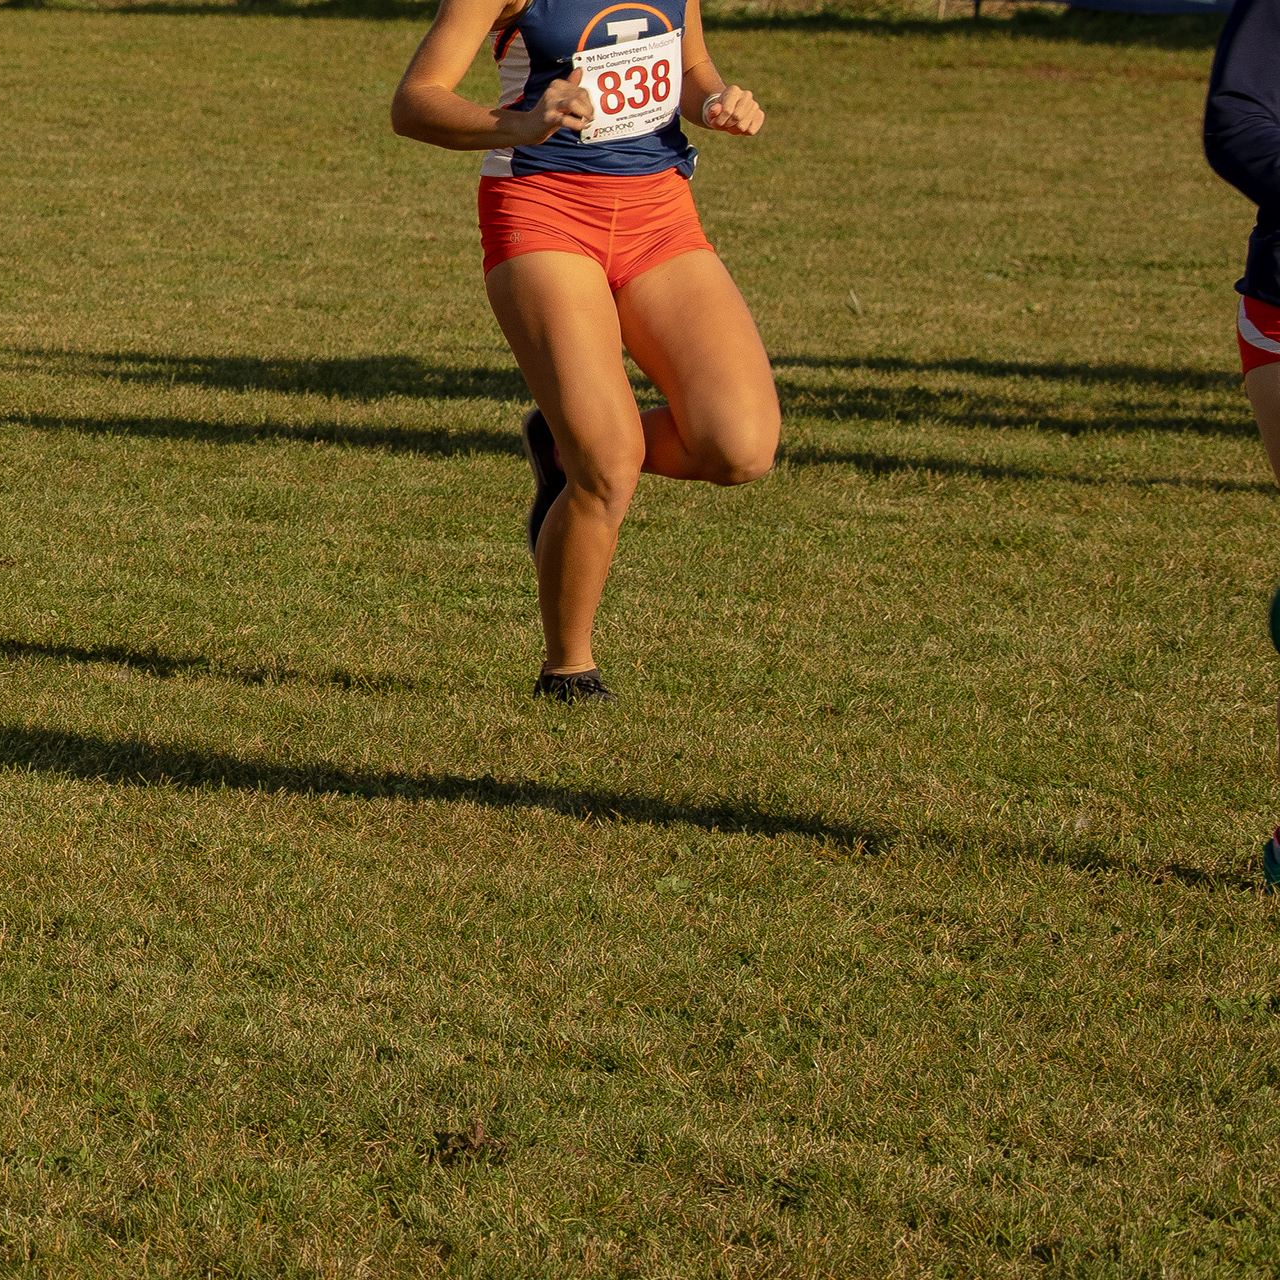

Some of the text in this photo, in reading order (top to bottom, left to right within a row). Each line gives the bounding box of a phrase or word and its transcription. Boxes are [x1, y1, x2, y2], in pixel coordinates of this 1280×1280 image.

[596, 45, 648, 61] Northwestern
[605, 59, 631, 68] Country
[631, 53, 654, 63] Course
[597, 59, 671, 115] 838
